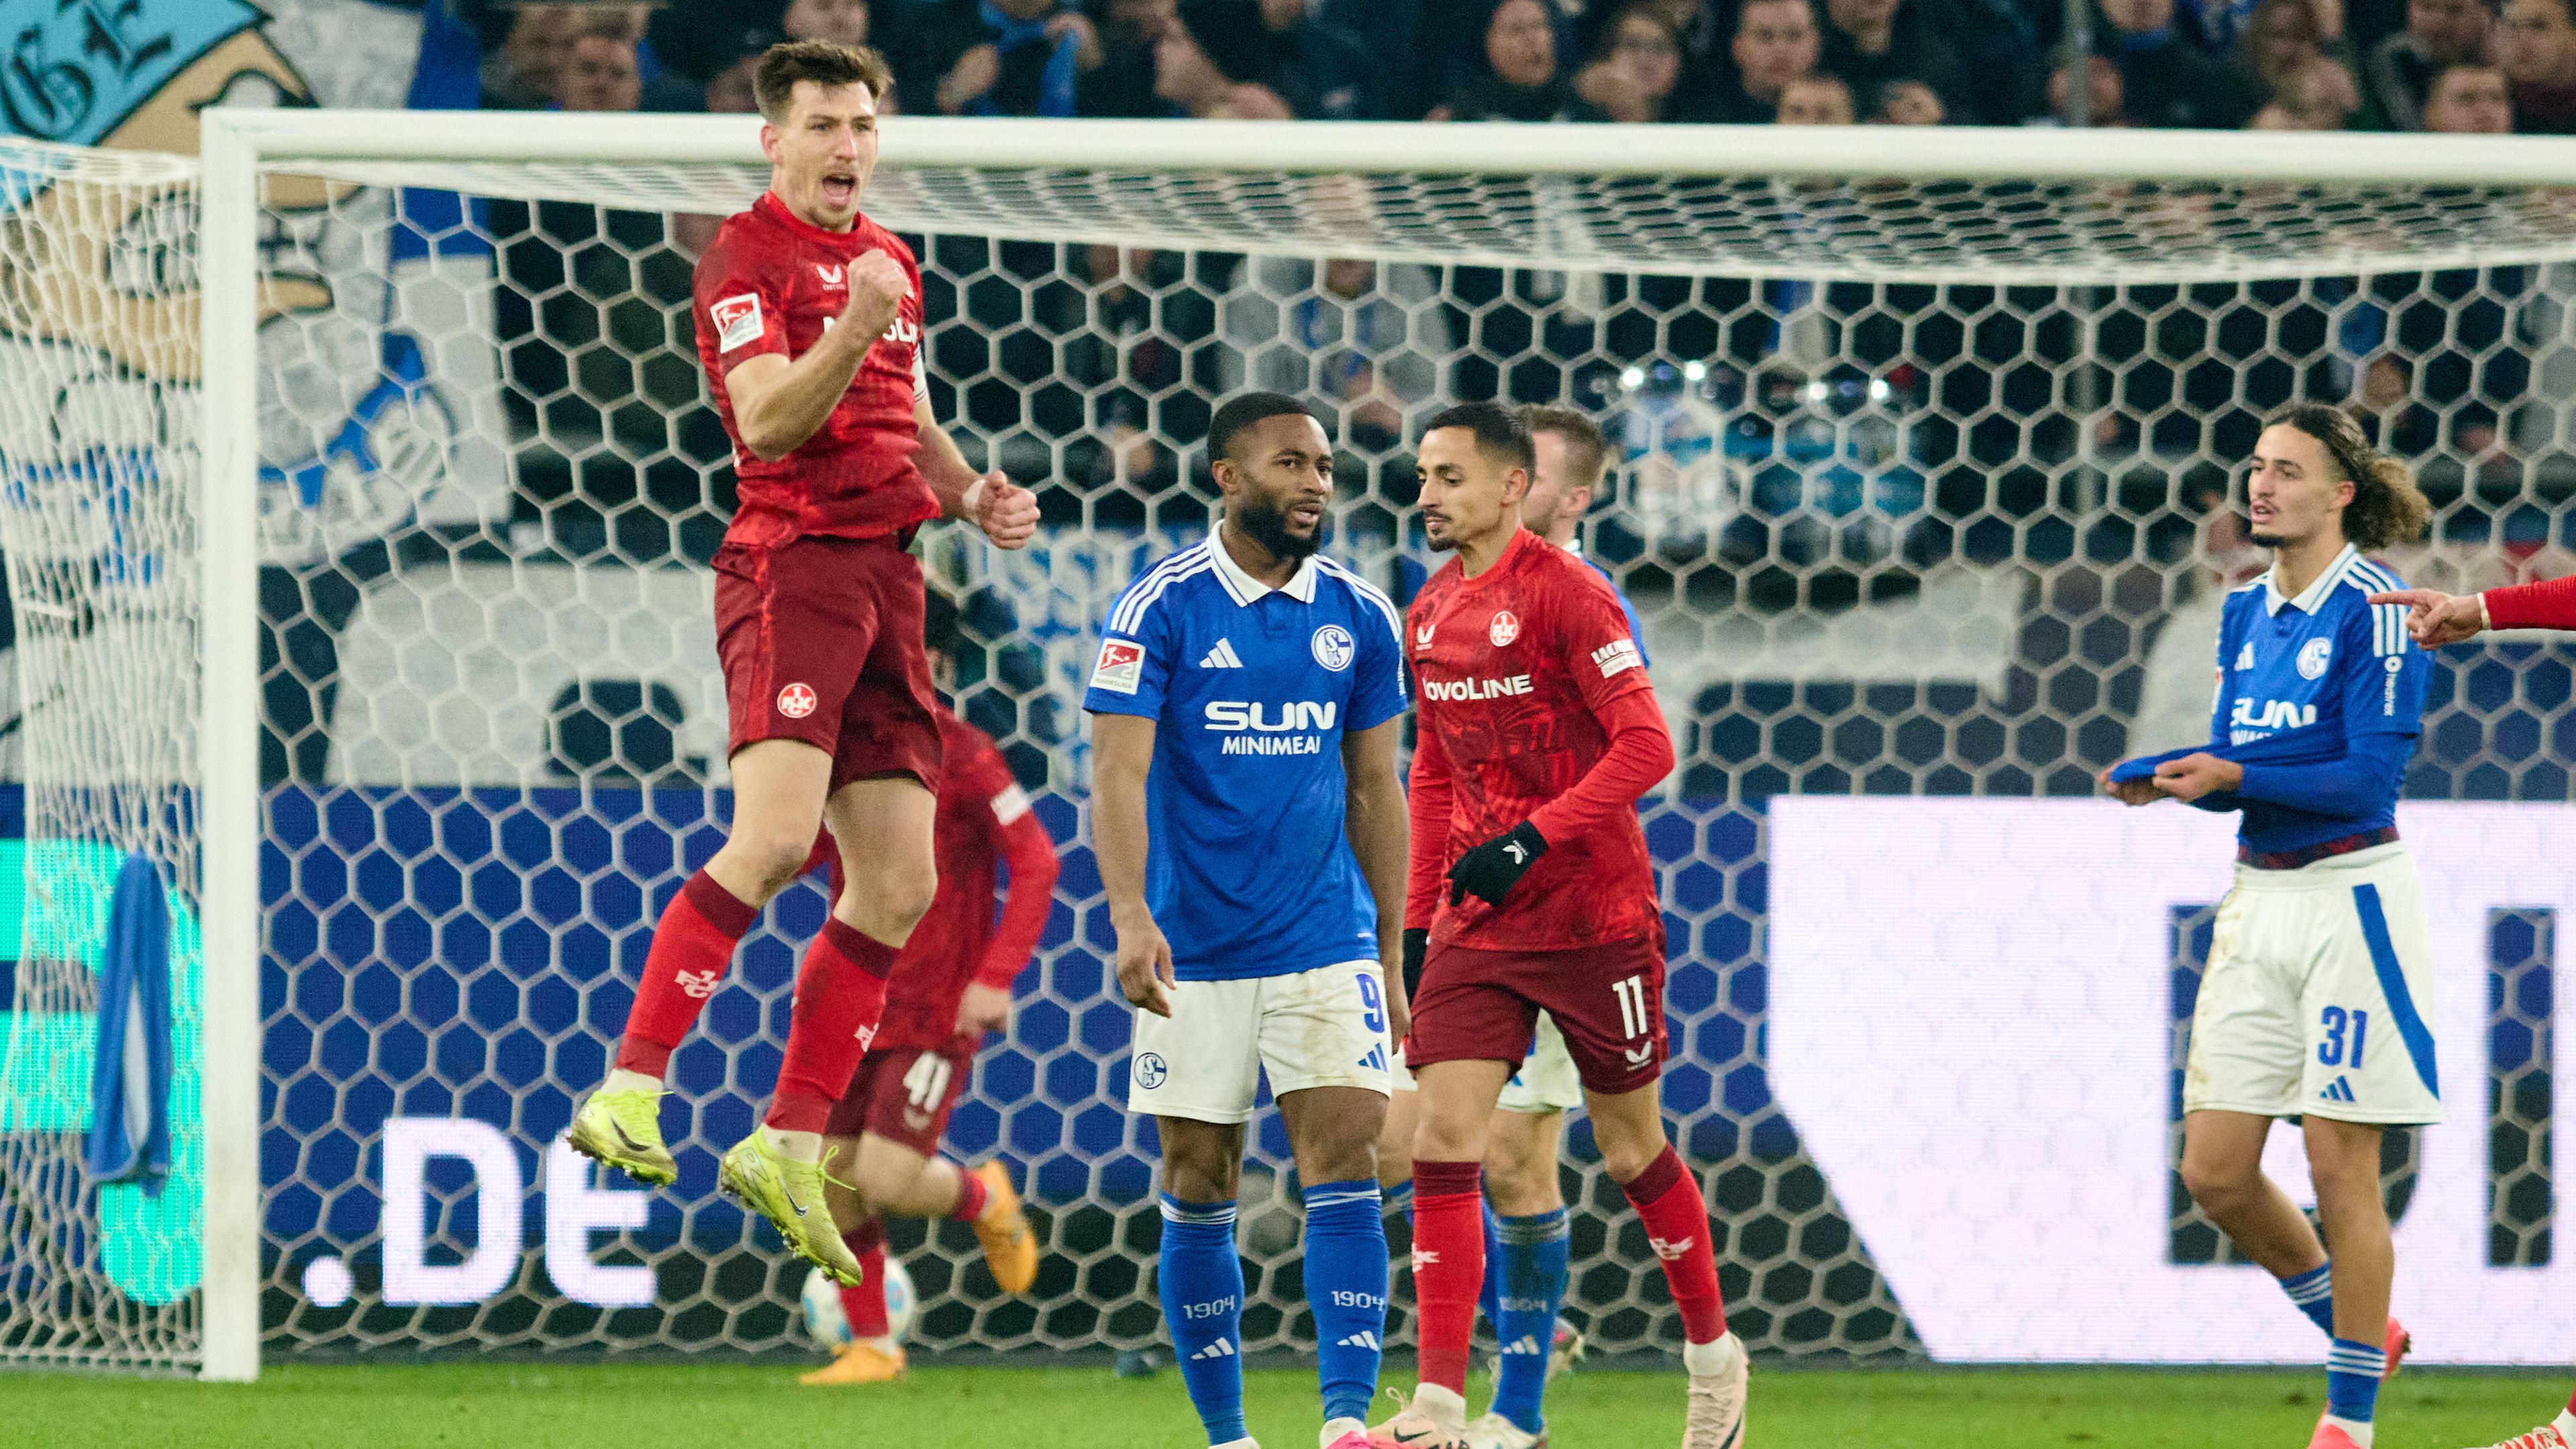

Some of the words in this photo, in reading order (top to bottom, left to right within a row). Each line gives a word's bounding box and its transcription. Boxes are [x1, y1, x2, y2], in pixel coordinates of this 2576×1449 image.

[1204, 701, 1336, 731] SUN
[1355, 973, 1386, 1034] 9
[1611, 974, 1648, 1040] 11
[2318, 1005, 2368, 1069] 31
[902, 1051, 953, 1113] 41
[1183, 1294, 1236, 1320] 1904
[1331, 1290, 1387, 1312] 1904
